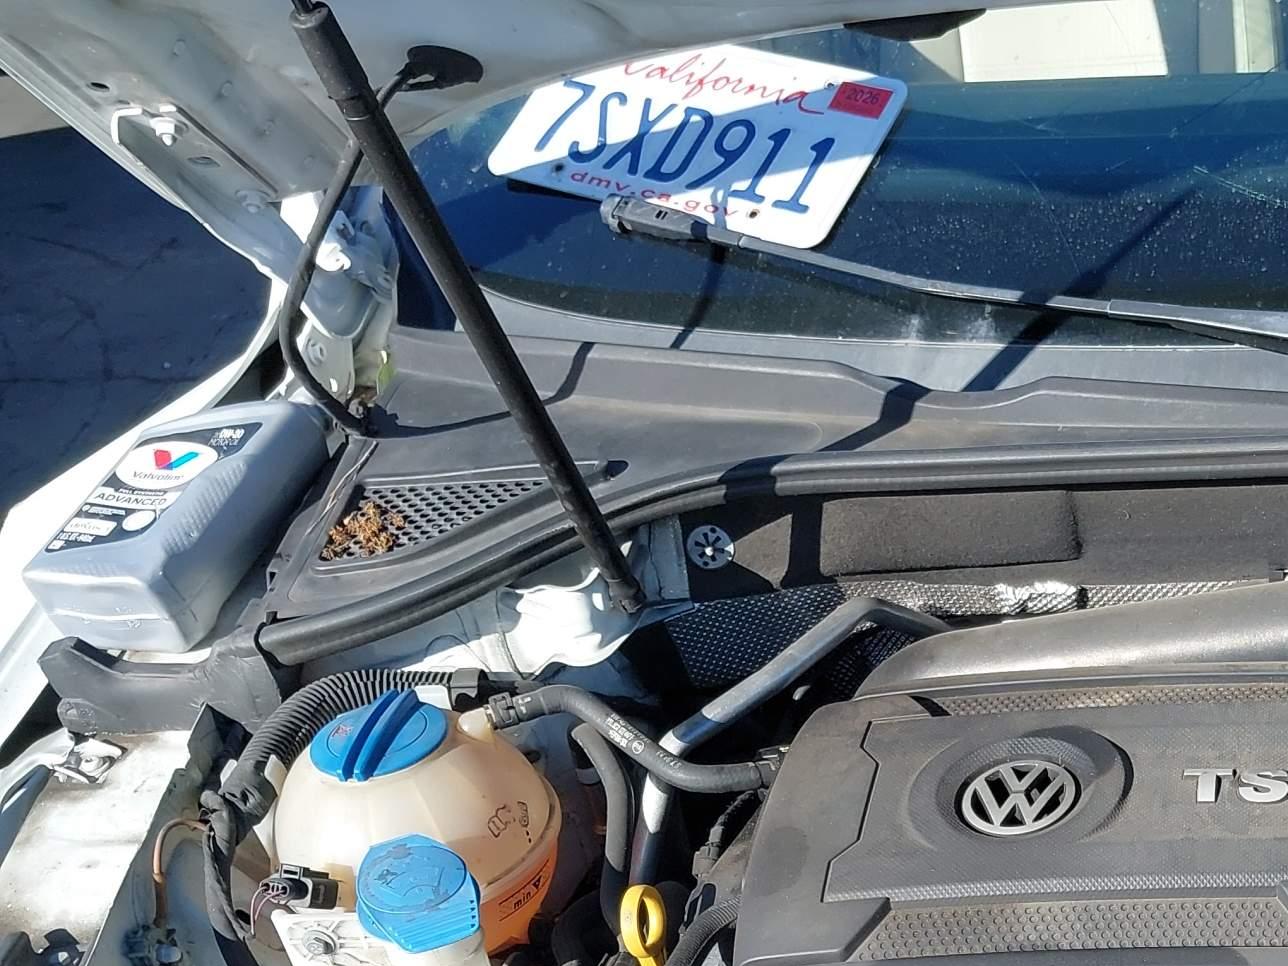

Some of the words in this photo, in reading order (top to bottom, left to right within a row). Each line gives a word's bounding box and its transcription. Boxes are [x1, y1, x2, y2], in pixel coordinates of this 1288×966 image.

[846, 87, 880, 106] 2026
[534, 80, 836, 214] 7SXD911
[570, 169, 739, 219] dmv.ca.gov
[94, 492, 167, 506] ADVANCED
[513, 890, 532, 910] min
